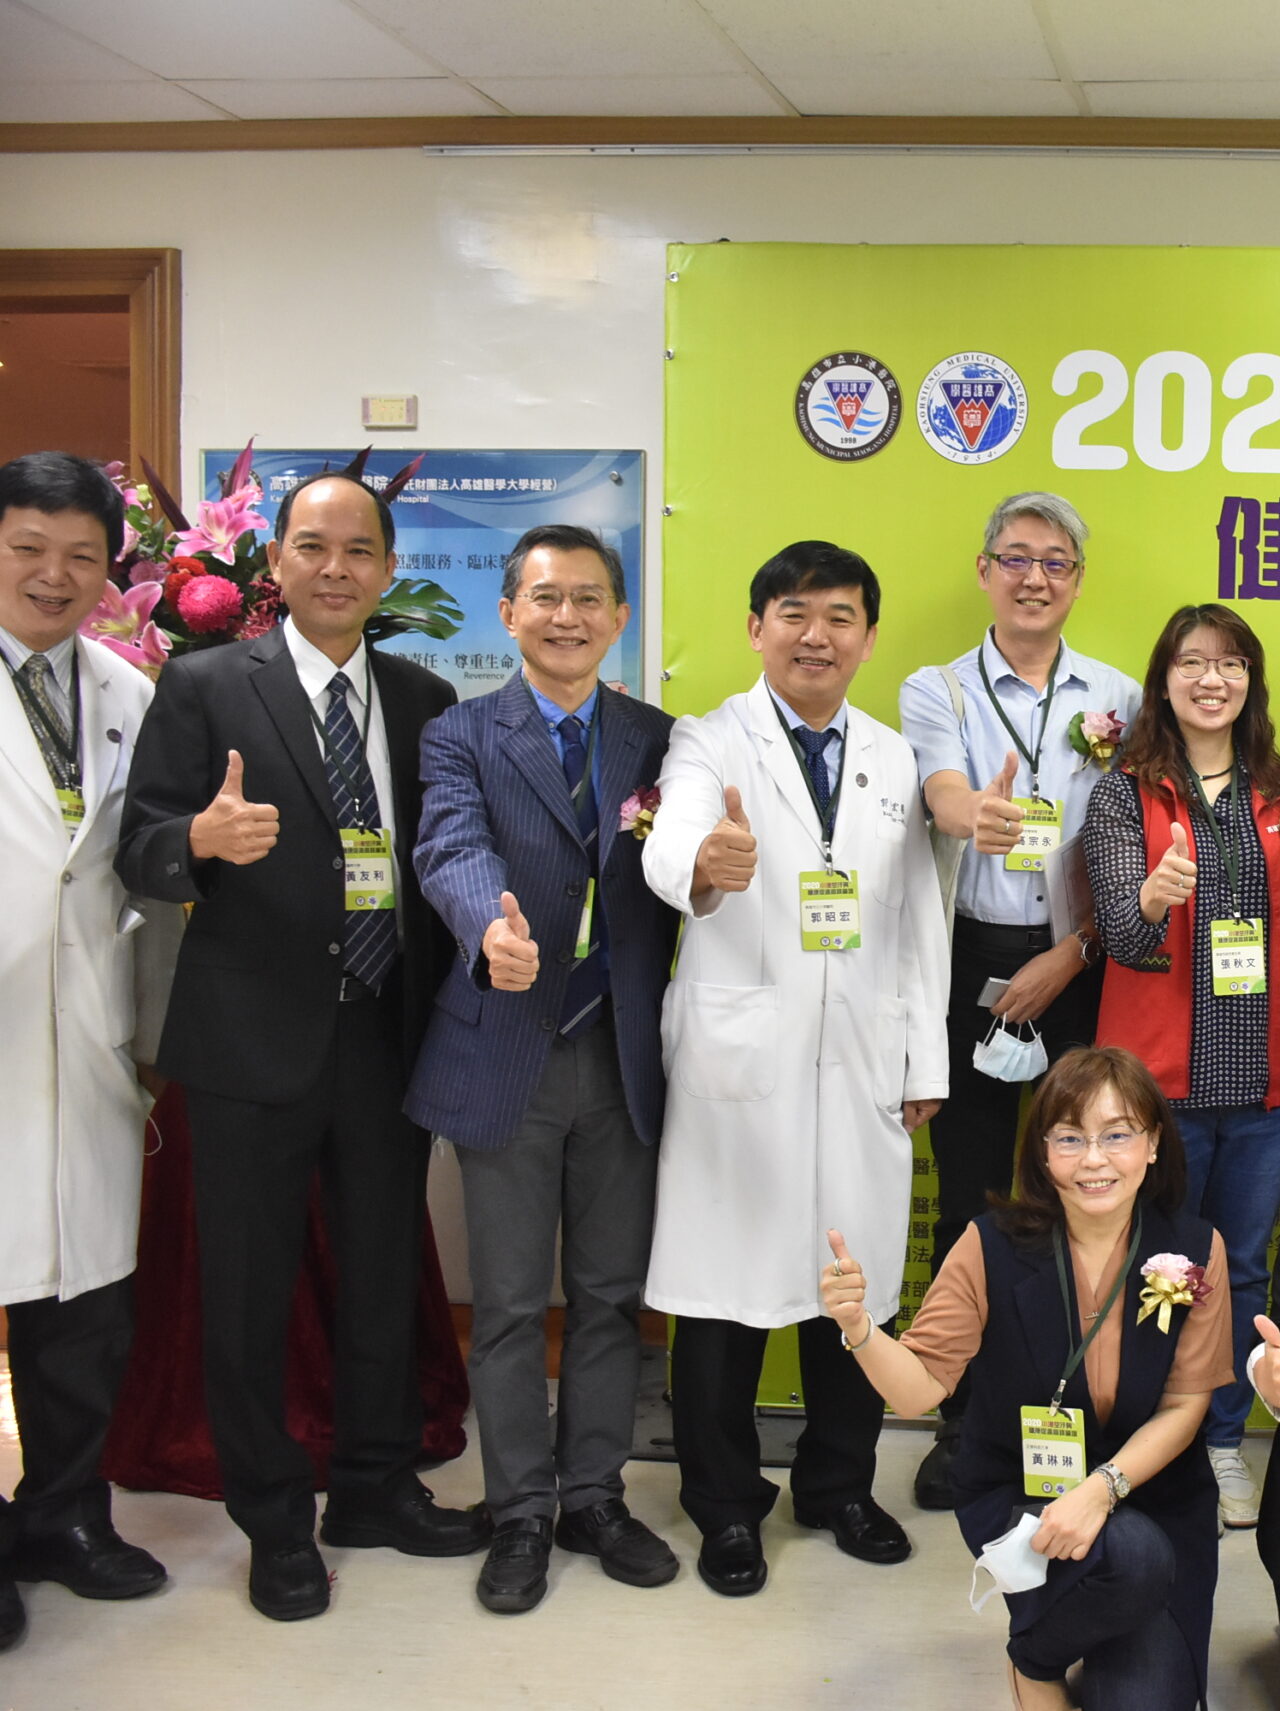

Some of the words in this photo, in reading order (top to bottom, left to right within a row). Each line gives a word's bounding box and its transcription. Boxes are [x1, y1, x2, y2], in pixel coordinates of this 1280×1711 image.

[918, 370, 941, 435] KAOHSIUNG
[946, 354, 997, 367] MEDICAL
[1003, 367, 1026, 433] UNIVERSITY
[464, 671, 504, 681] Reverence
[1032, 1453, 1073, 1468] 黃琳琳
